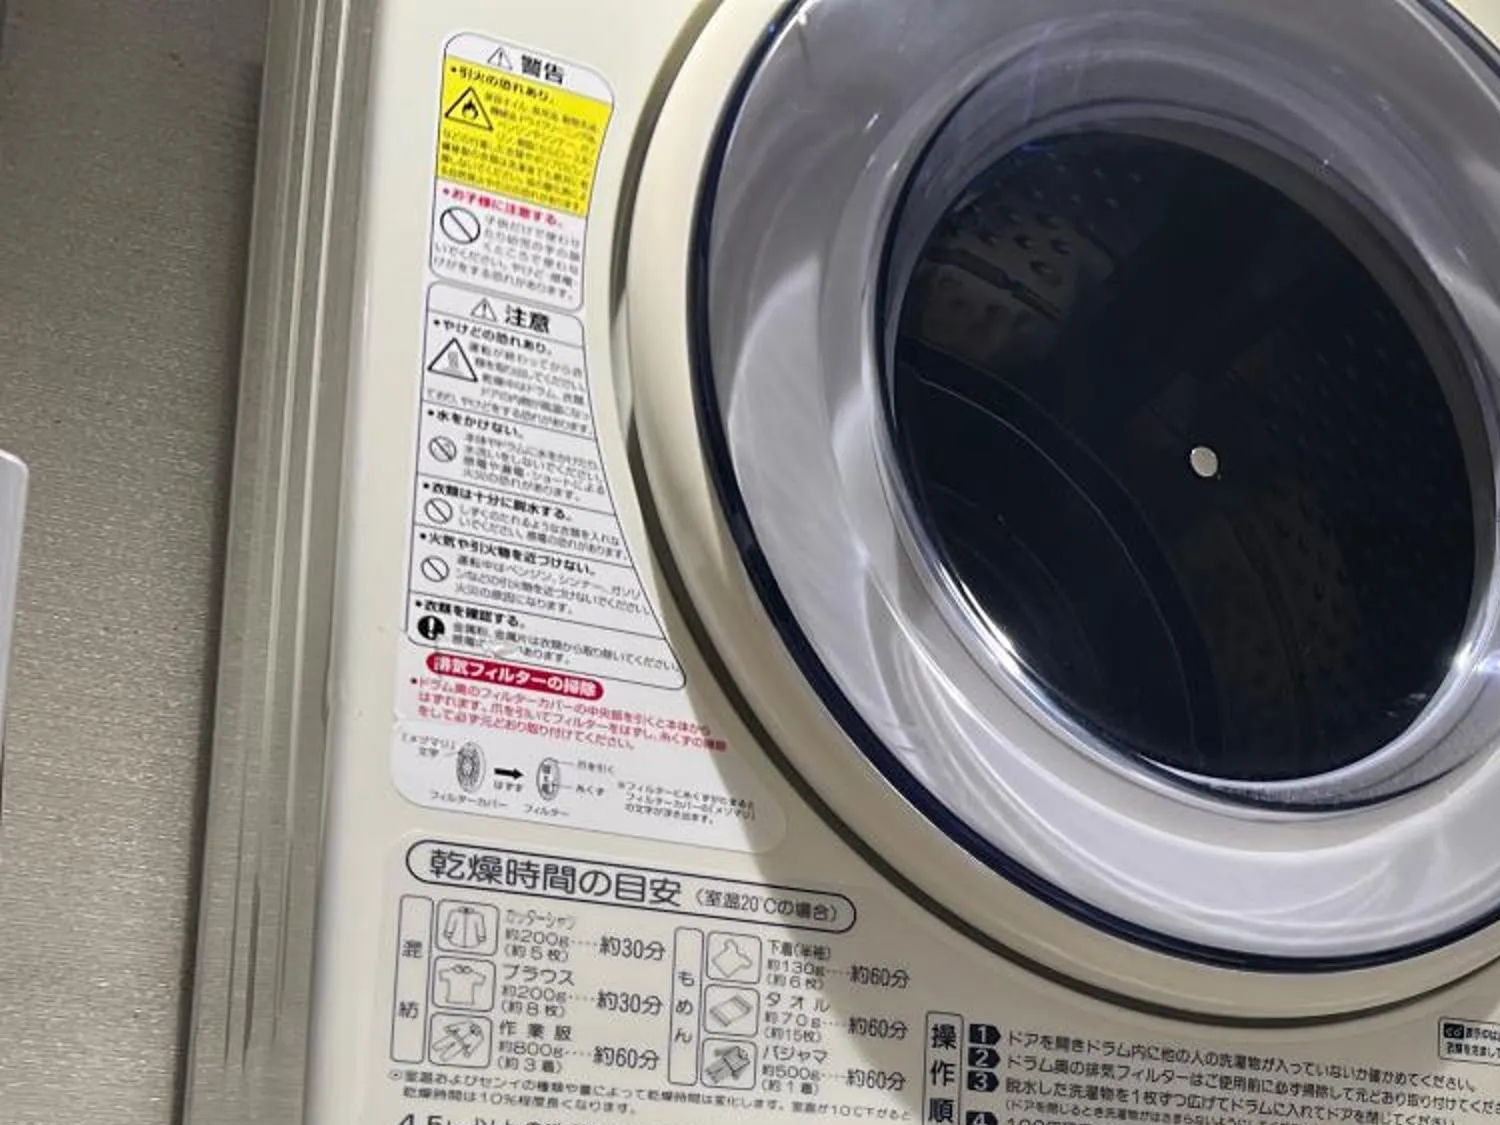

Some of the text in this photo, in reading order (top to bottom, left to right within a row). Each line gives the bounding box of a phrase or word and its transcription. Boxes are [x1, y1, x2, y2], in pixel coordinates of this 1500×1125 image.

[504, 304, 549, 333] 注意
[429, 848, 682, 907] 乾燥時間の目安
[599, 935, 665, 961] 約30分
[849, 964, 911, 989] 約60分
[595, 989, 664, 1016] 約30分
[847, 1017, 909, 1040] 約60分
[592, 1046, 660, 1072] 約60分
[975, 1048, 989, 1067] 2
[846, 1068, 907, 1092] 約60分
[974, 1072, 988, 1091] 3
